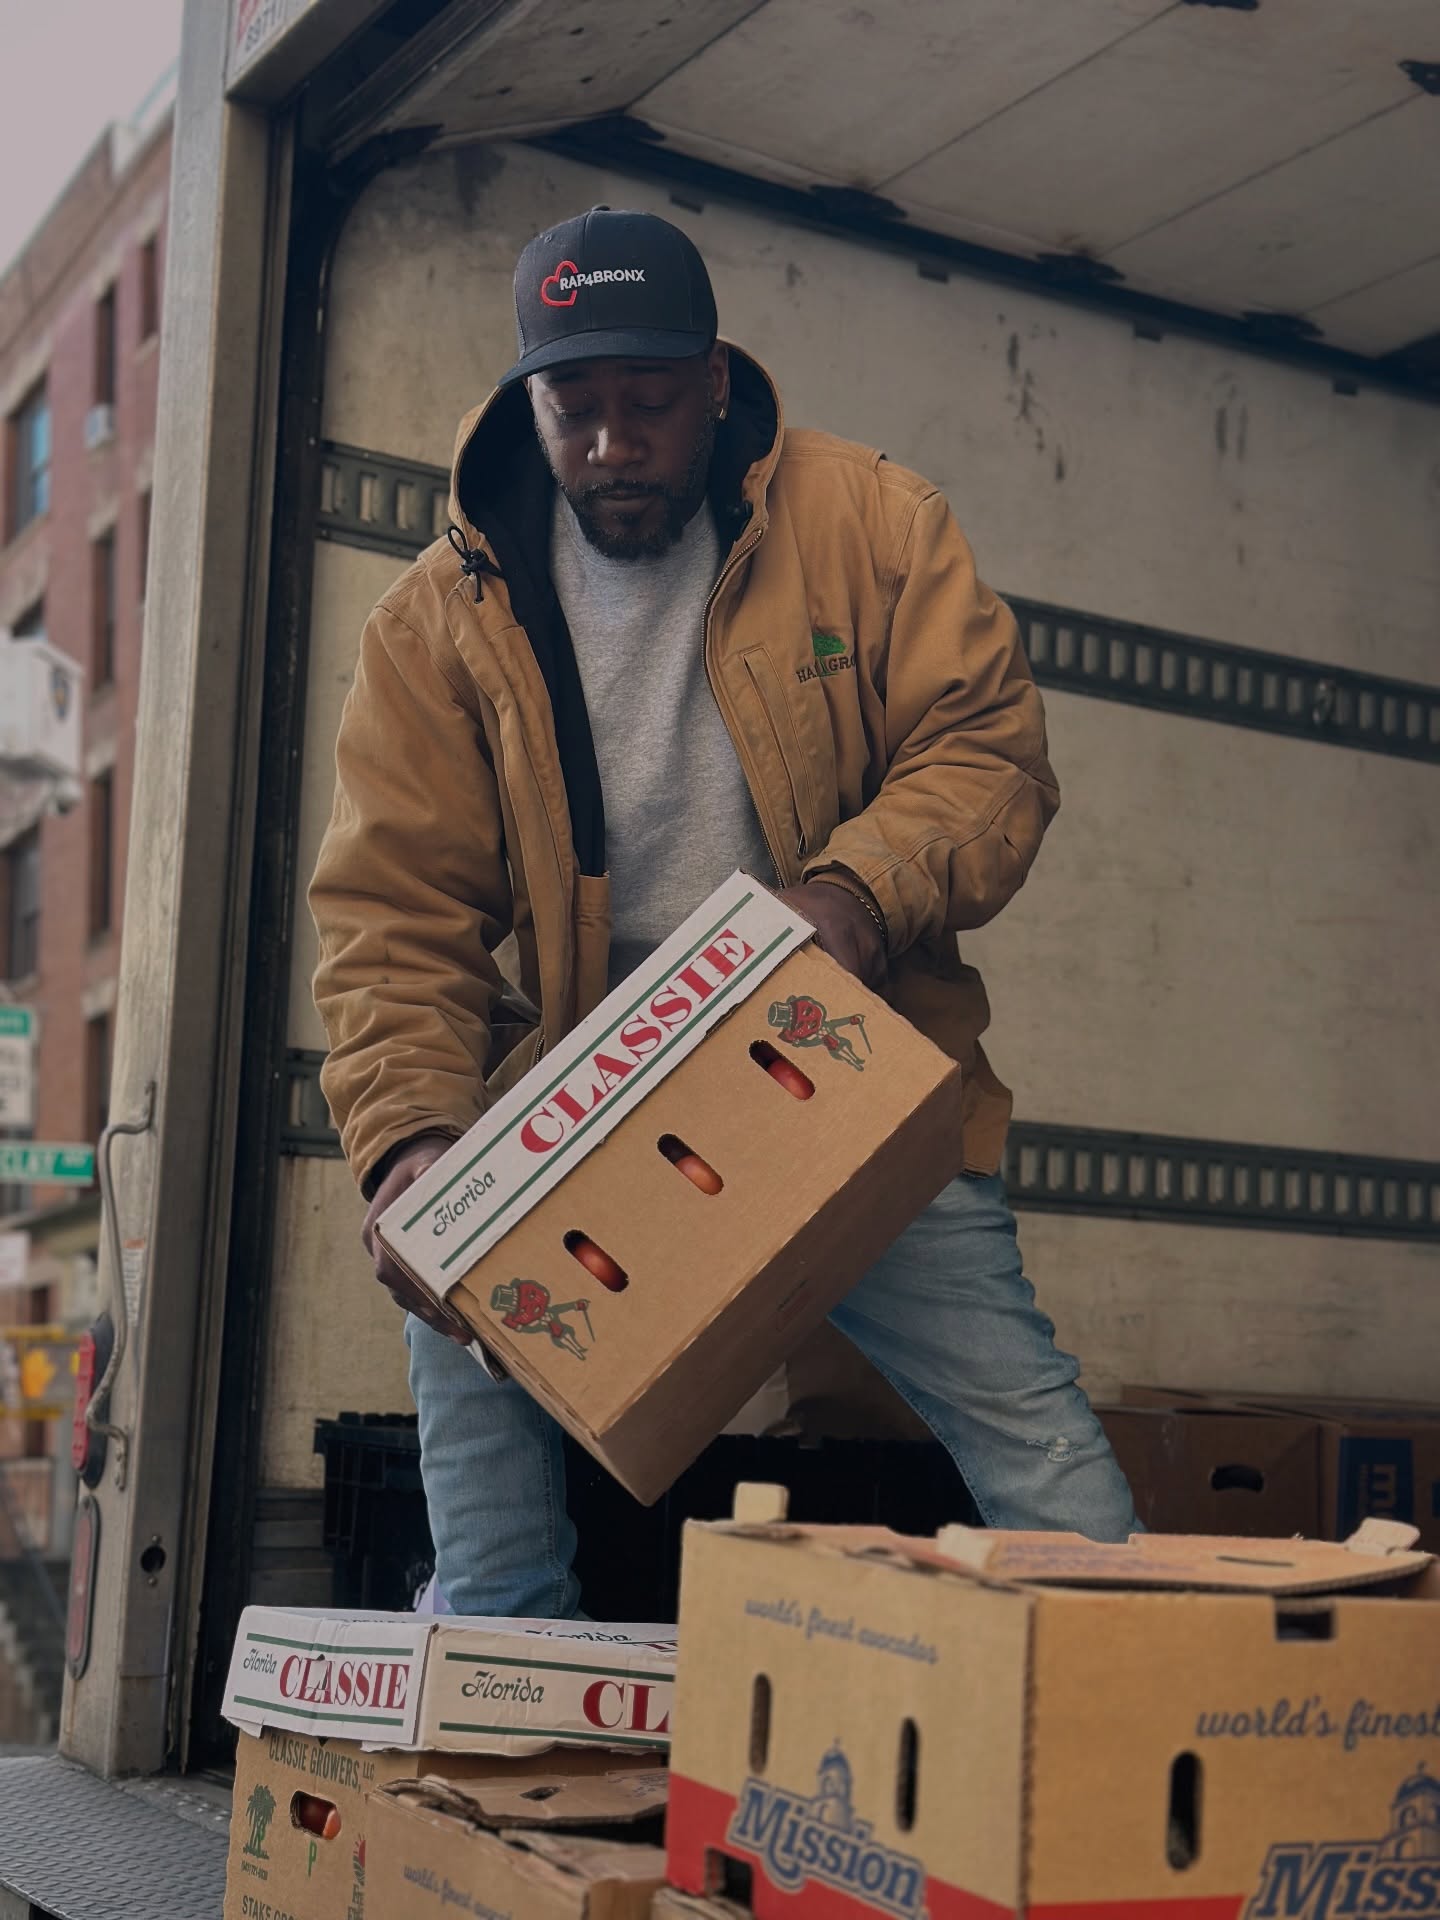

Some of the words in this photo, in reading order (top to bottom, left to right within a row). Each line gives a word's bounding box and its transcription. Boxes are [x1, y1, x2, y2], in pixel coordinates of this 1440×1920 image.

[559, 269, 646, 291] RAP4BRONX
[520, 928, 755, 1154] CLASSIE
[433, 1171, 496, 1236] Florida
[243, 1648, 278, 1675] Florida
[279, 1654, 411, 1710] CLASSIE
[461, 1671, 545, 1704] Florida
[1195, 1696, 1339, 1739] world's
[268, 1733, 309, 1772] CLASSIE
[736, 1786, 924, 1908] Mission
